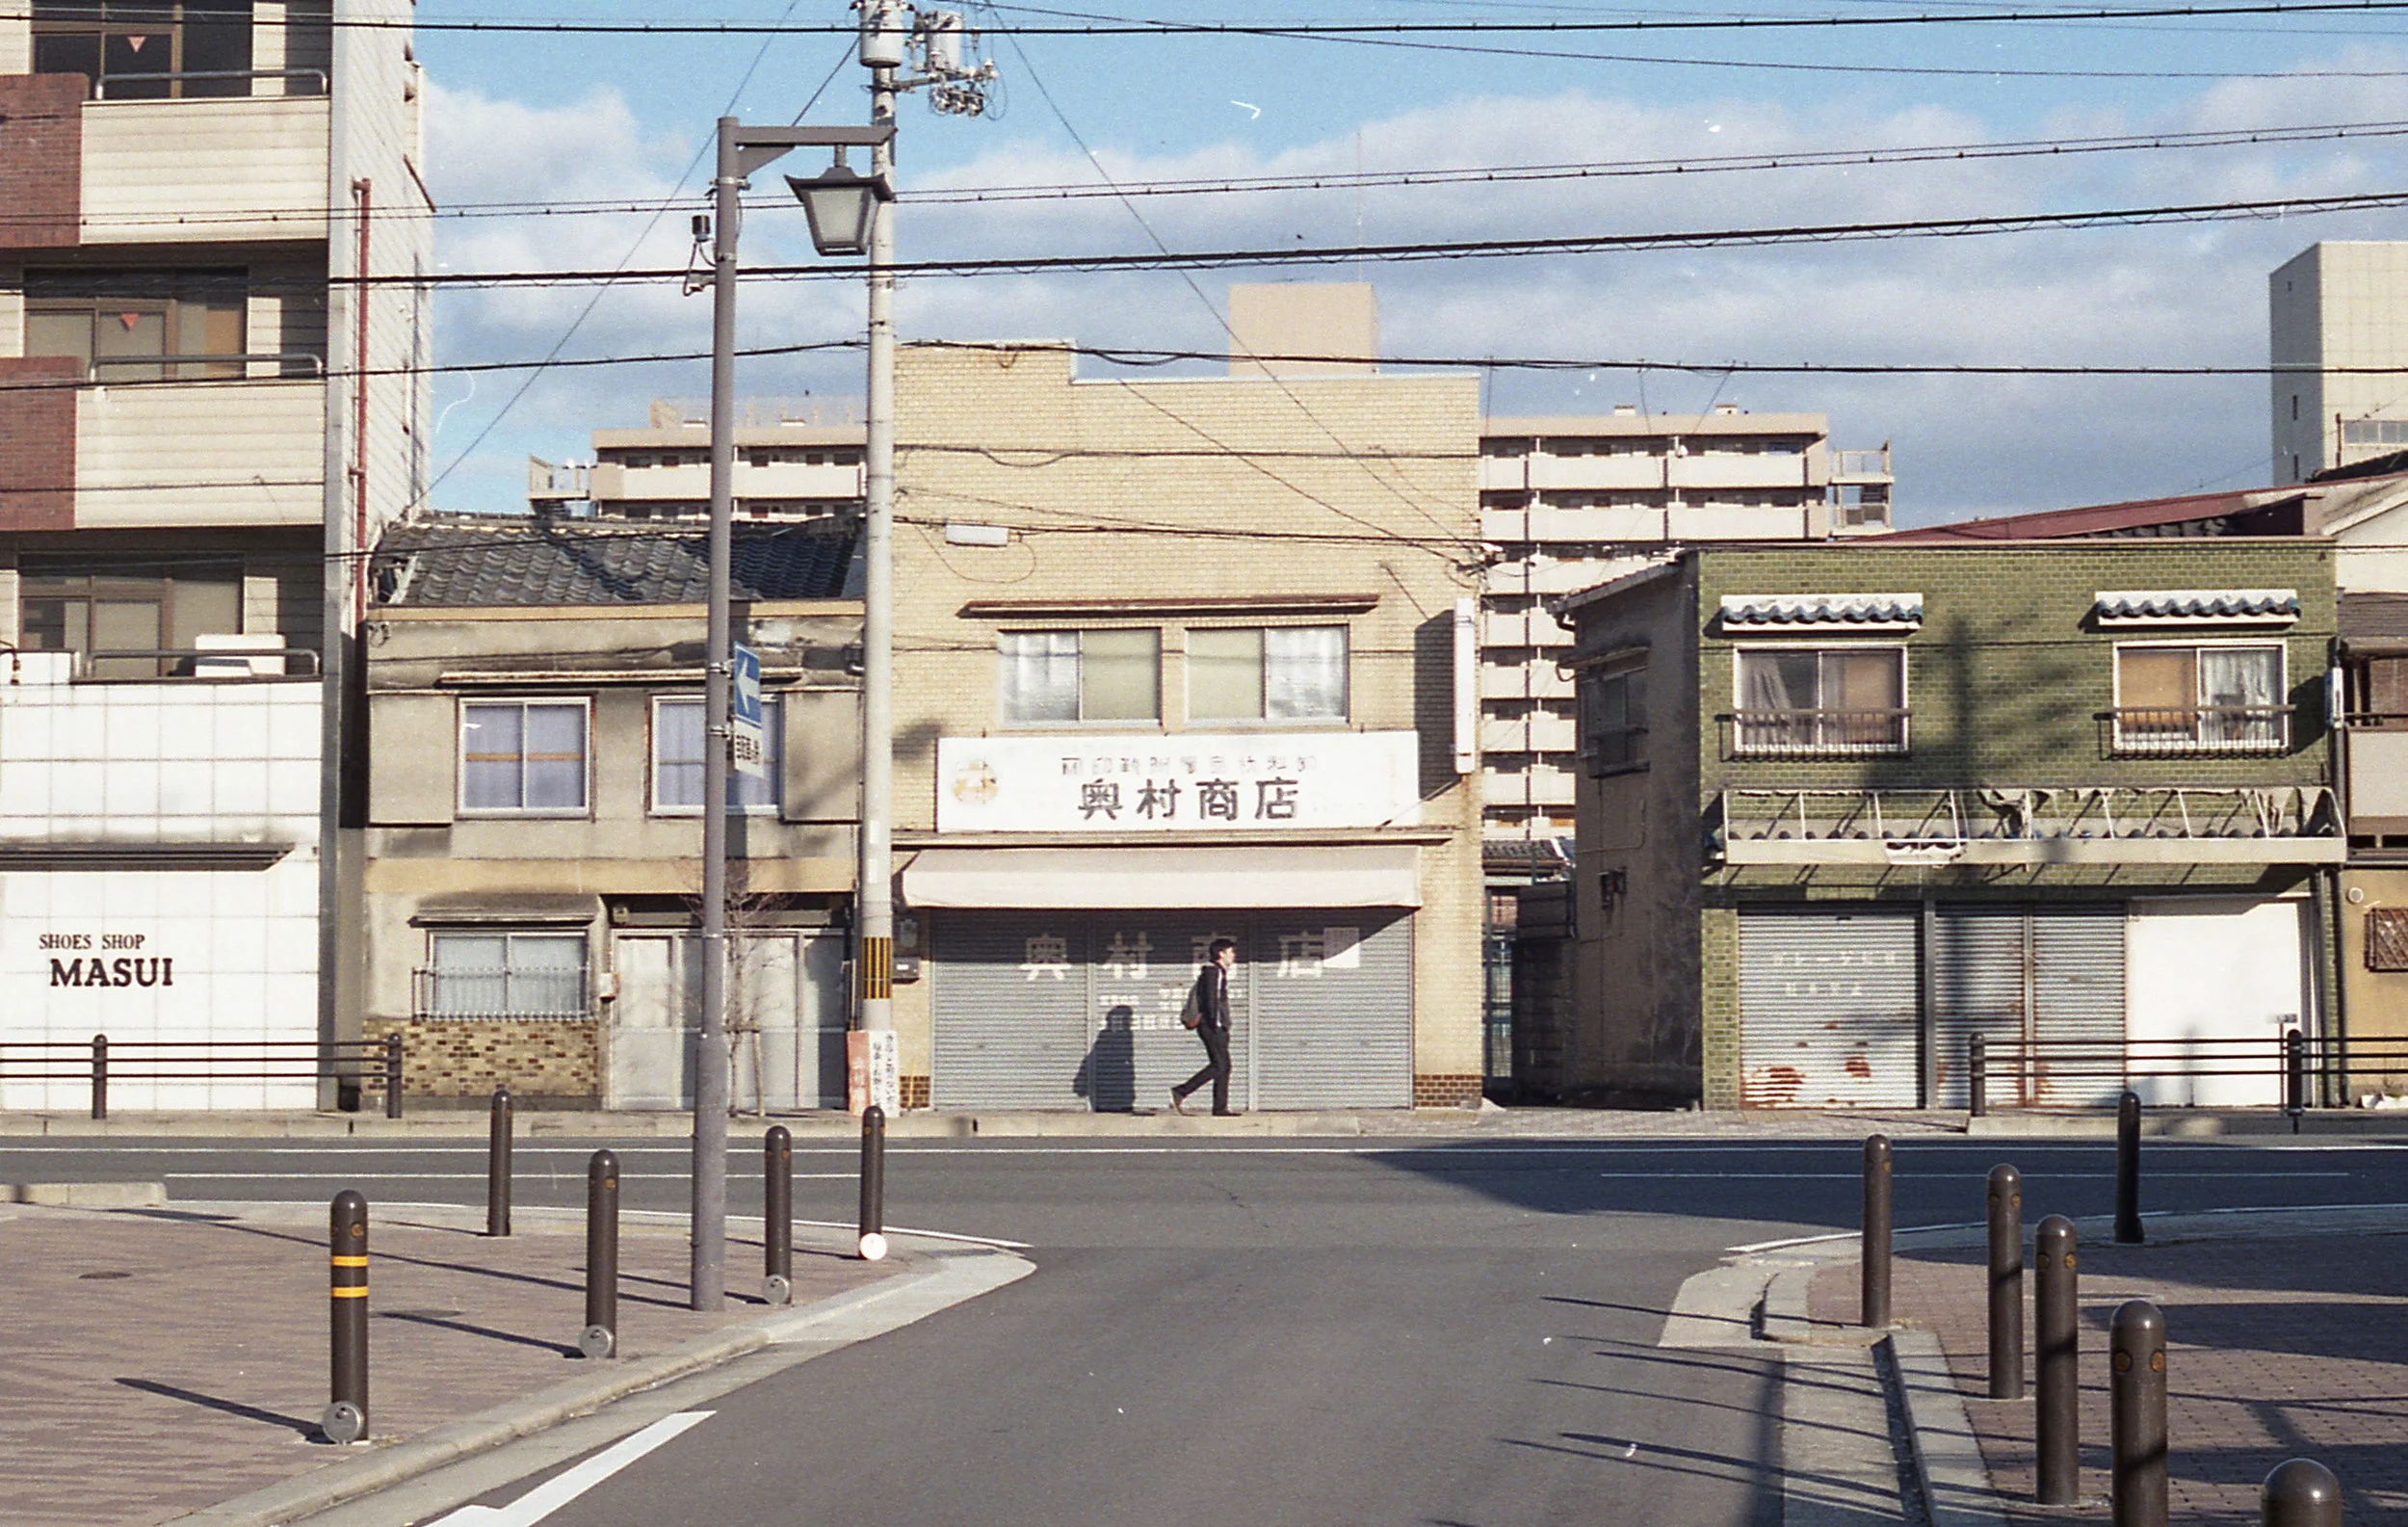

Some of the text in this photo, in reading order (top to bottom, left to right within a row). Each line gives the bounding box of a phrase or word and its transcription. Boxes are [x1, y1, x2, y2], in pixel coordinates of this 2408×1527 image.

[1077, 776, 1299, 822] 奥村商店
[39, 934, 145, 950] SHOES SHOP
[50, 958, 173, 987] MASUI
